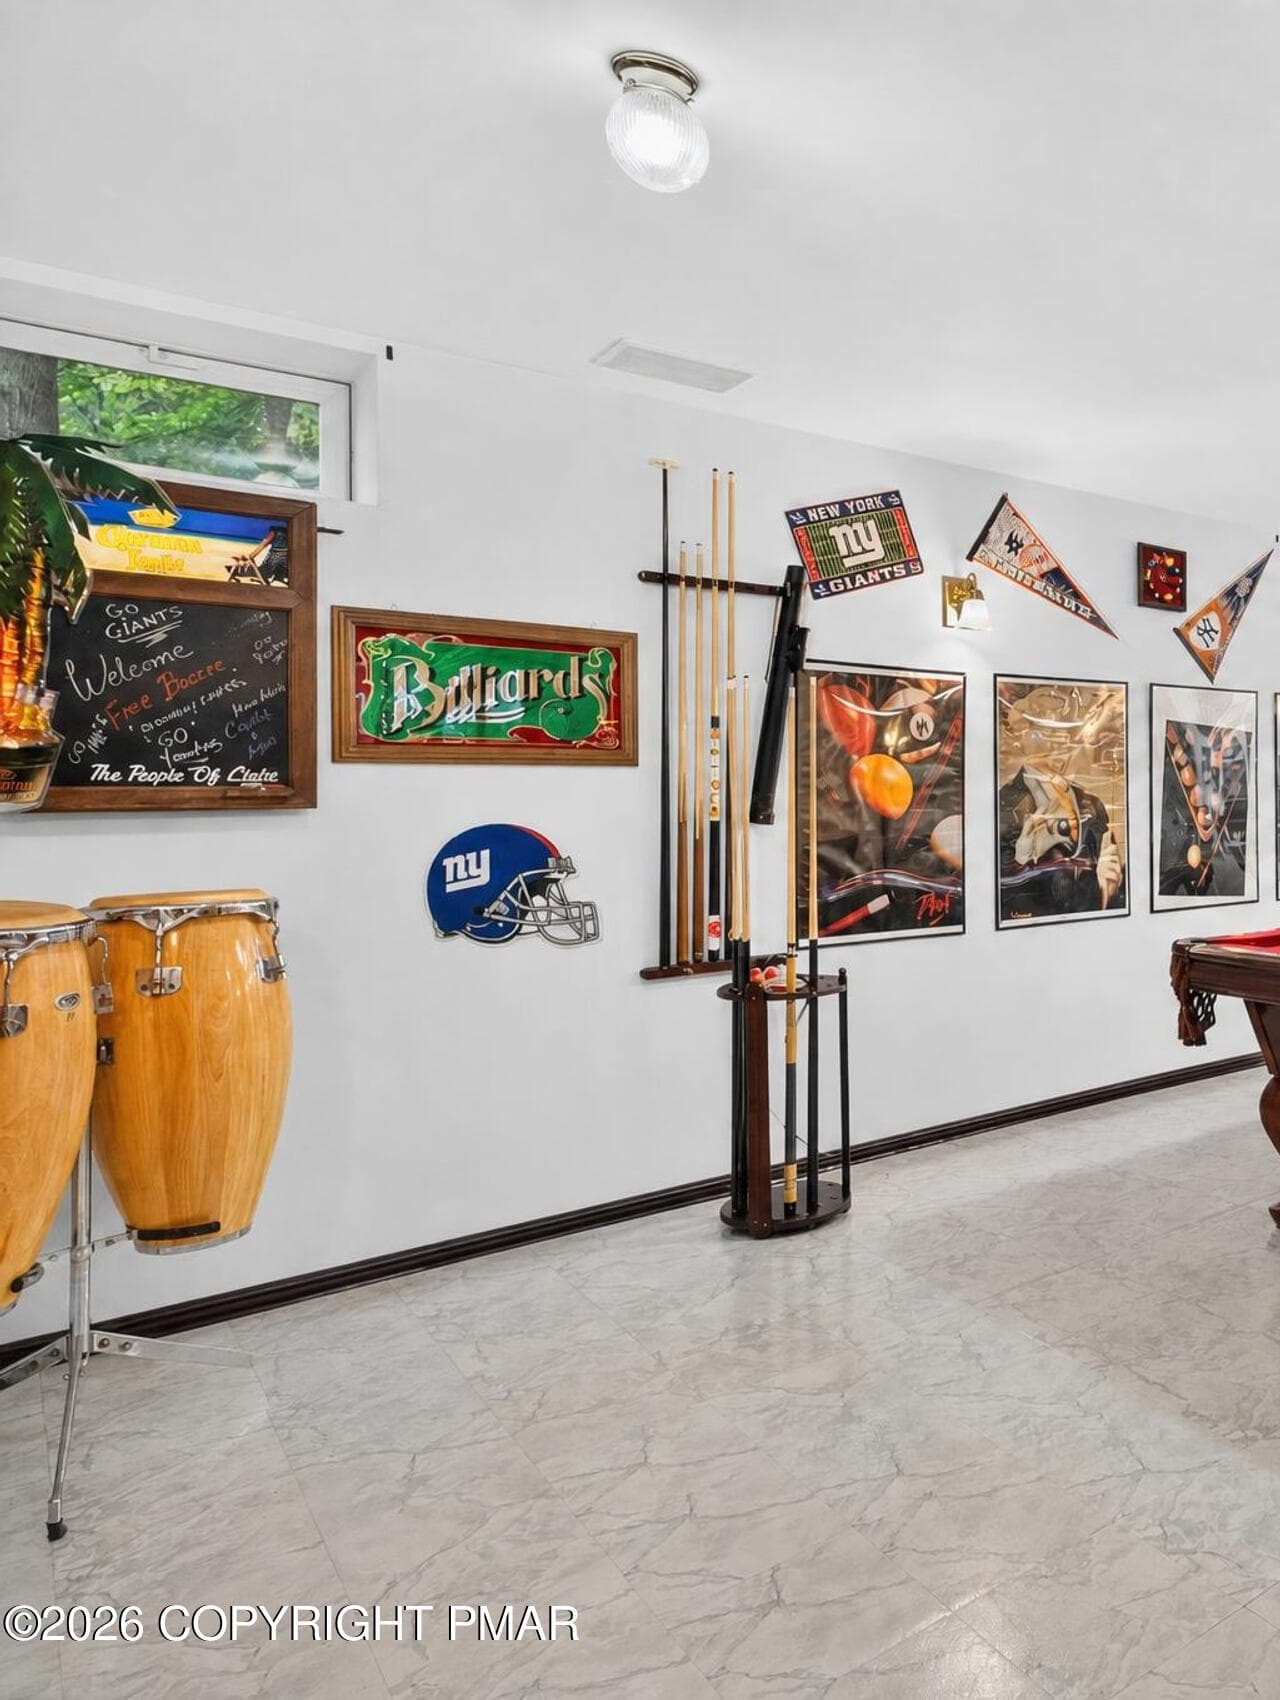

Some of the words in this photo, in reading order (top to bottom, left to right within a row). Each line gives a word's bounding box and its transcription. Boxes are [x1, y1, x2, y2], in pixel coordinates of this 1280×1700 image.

[807, 503, 841, 521] NEW
[844, 496, 886, 513] YORK
[829, 564, 906, 592] GIANTS
[105, 603, 139, 618] GO
[105, 605, 183, 639] GIANTS
[65, 645, 194, 702] Welcome
[388, 655, 609, 734] Billiards
[103, 694, 154, 731] Free
[158, 727, 188, 748] GO
[90, 763, 123, 782] The
[127, 764, 185, 786] People
[187, 765, 221, 786] Of
